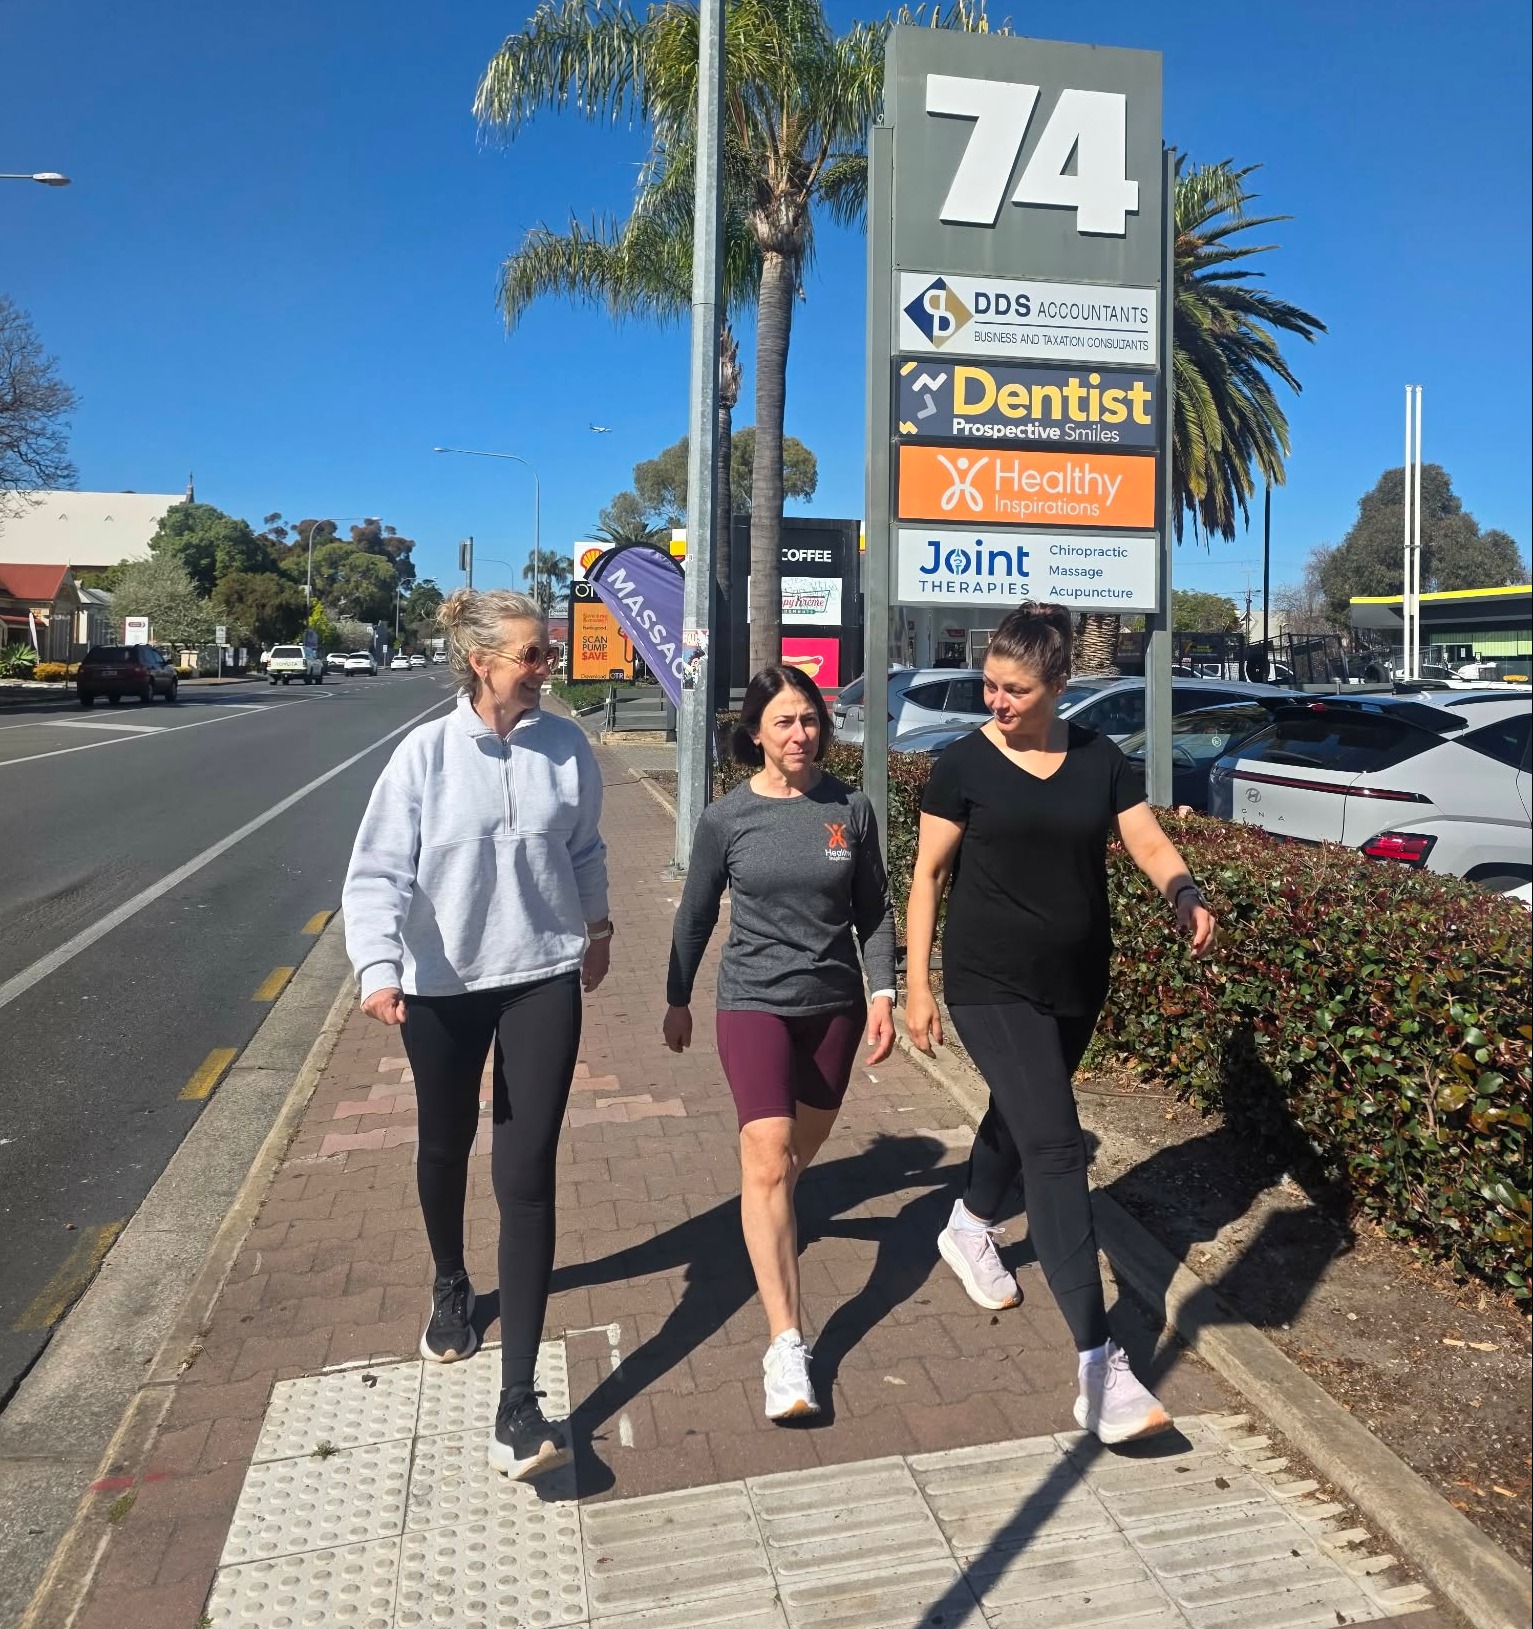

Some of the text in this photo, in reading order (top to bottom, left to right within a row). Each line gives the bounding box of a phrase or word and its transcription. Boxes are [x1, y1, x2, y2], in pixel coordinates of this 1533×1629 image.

[925, 73, 1139, 235] 74
[974, 291, 1149, 323] DDS ACCOUNTANTS
[974, 331, 1149, 351] BUSINESS AND TAXATION CONSULTANTS
[953, 365, 1152, 425] Dentist
[952, 418, 1120, 443] Prospective Smiles
[995, 458, 1122, 507] Healthy
[995, 494, 1100, 518] Inspirations
[918, 539, 1030, 578] Joint
[1049, 545, 1128, 559] Chiropractic
[1049, 565, 1104, 579] Massage
[575, 583, 596, 598] OT
[918, 580, 1030, 595] THERAPIES
[1049, 585, 1134, 600] Acupuncture
[582, 635, 608, 644] SCAN
[582, 643, 608, 652] PUMP
[581, 651, 608, 661] $AVE
